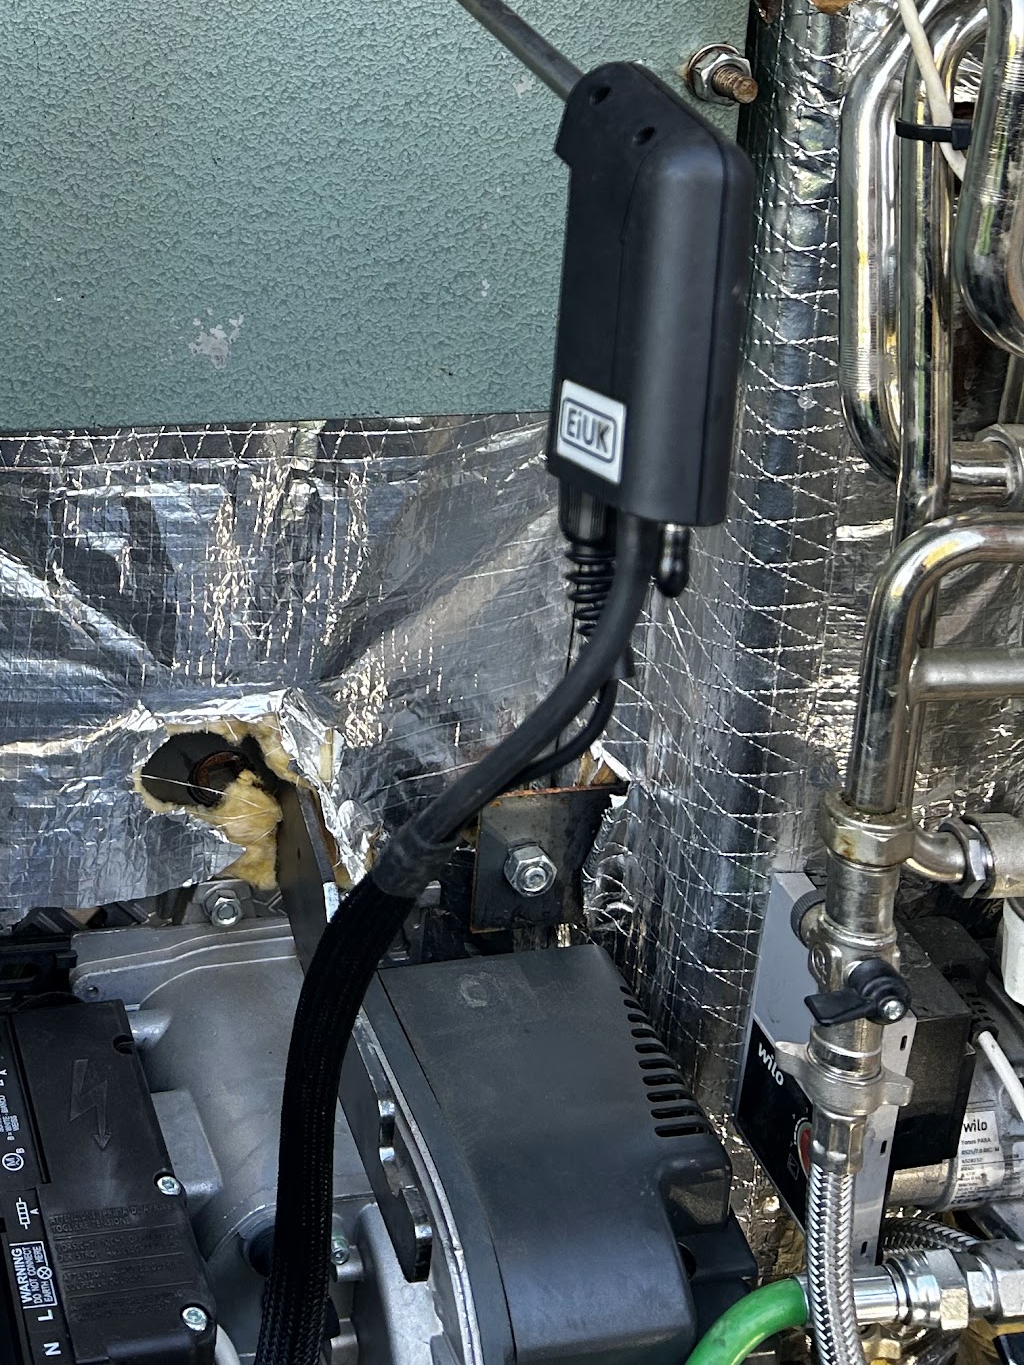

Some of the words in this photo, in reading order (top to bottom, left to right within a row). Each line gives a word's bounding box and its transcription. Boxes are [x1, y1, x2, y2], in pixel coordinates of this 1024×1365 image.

[566, 407, 611, 454] EiUK
[757, 1040, 785, 1086] wilo
[963, 1119, 988, 1133] wilo
[10, 1247, 34, 1303] WARNING
[43, 1341, 62, 1357] N
